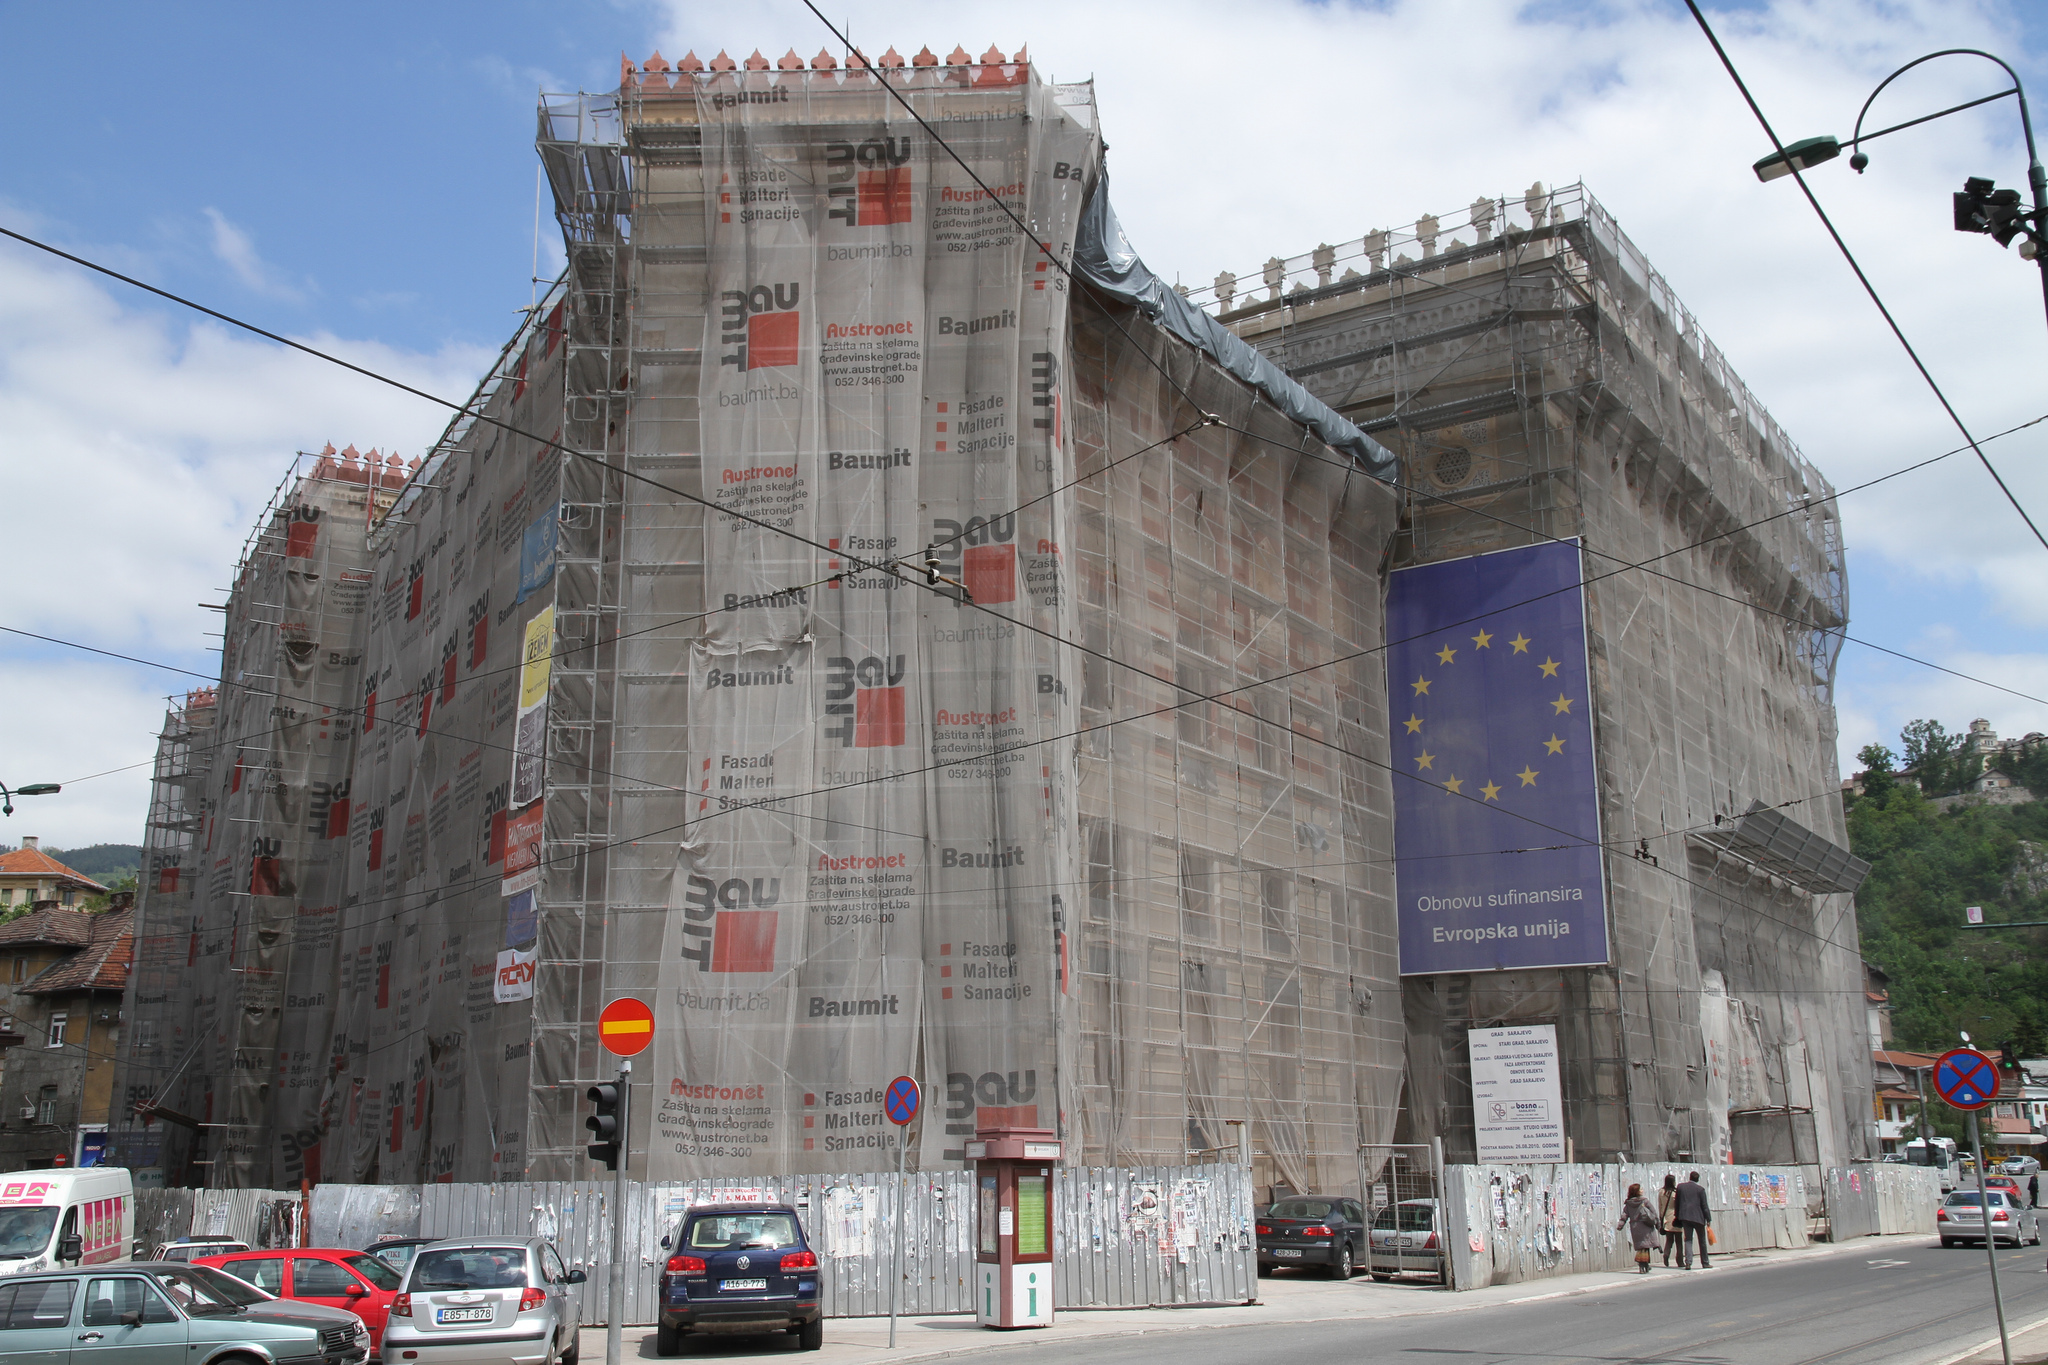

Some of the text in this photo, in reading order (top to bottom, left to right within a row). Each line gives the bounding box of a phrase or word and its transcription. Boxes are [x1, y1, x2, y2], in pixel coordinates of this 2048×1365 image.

[740, 206, 800, 225] Sanacije
[935, 202, 970, 216] Zaštita
[974, 205, 985, 215] na
[932, 215, 993, 230] Građevinske
[828, 241, 913, 261] baumit.ba
[827, 320, 913, 339] Austronet
[938, 309, 1016, 335] Baumit
[822, 338, 919, 352] Zaštita na skelama
[819, 350, 922, 365] Građevinske ograde
[823, 362, 918, 377] www.austronet.ba
[719, 383, 799, 407] baumit.ba
[958, 395, 1004, 416] Fasade
[957, 413, 1004, 435] Malteri
[957, 432, 1015, 454] Sanacije
[829, 448, 911, 470] Baumit
[750, 485, 763, 494] na
[934, 622, 1016, 643] baumit.ba
[706, 664, 794, 690] Baumit
[972, 730, 985, 739] na
[821, 767, 905, 786] baumit.ba
[818, 853, 906, 871] Austronet
[850, 875, 864, 885] na
[1417, 886, 1583, 912] Obnovu sufinansira
[1432, 919, 1570, 944] Evropska unija
[962, 941, 1017, 957] Fasade
[676, 986, 770, 1011] baumit.ba
[964, 984, 1032, 1001] Sanacije
[809, 994, 899, 1018] Baumit
[1507, 1029, 1532, 1037] SARAJEVO
[505, 1038, 530, 1062] Baumit
[670, 1078, 765, 1101] Austronet
[825, 1087, 884, 1107] Fasade
[661, 1098, 772, 1116] Zaštita na skelama
[657, 1113, 775, 1131] Građevinske ograde
[825, 1110, 883, 1130] Malteri
[661, 1129, 769, 1145] www.austronet.ba
[824, 1131, 895, 1152] Sanacije
[443, 1308, 492, 1320] E85-T-878
